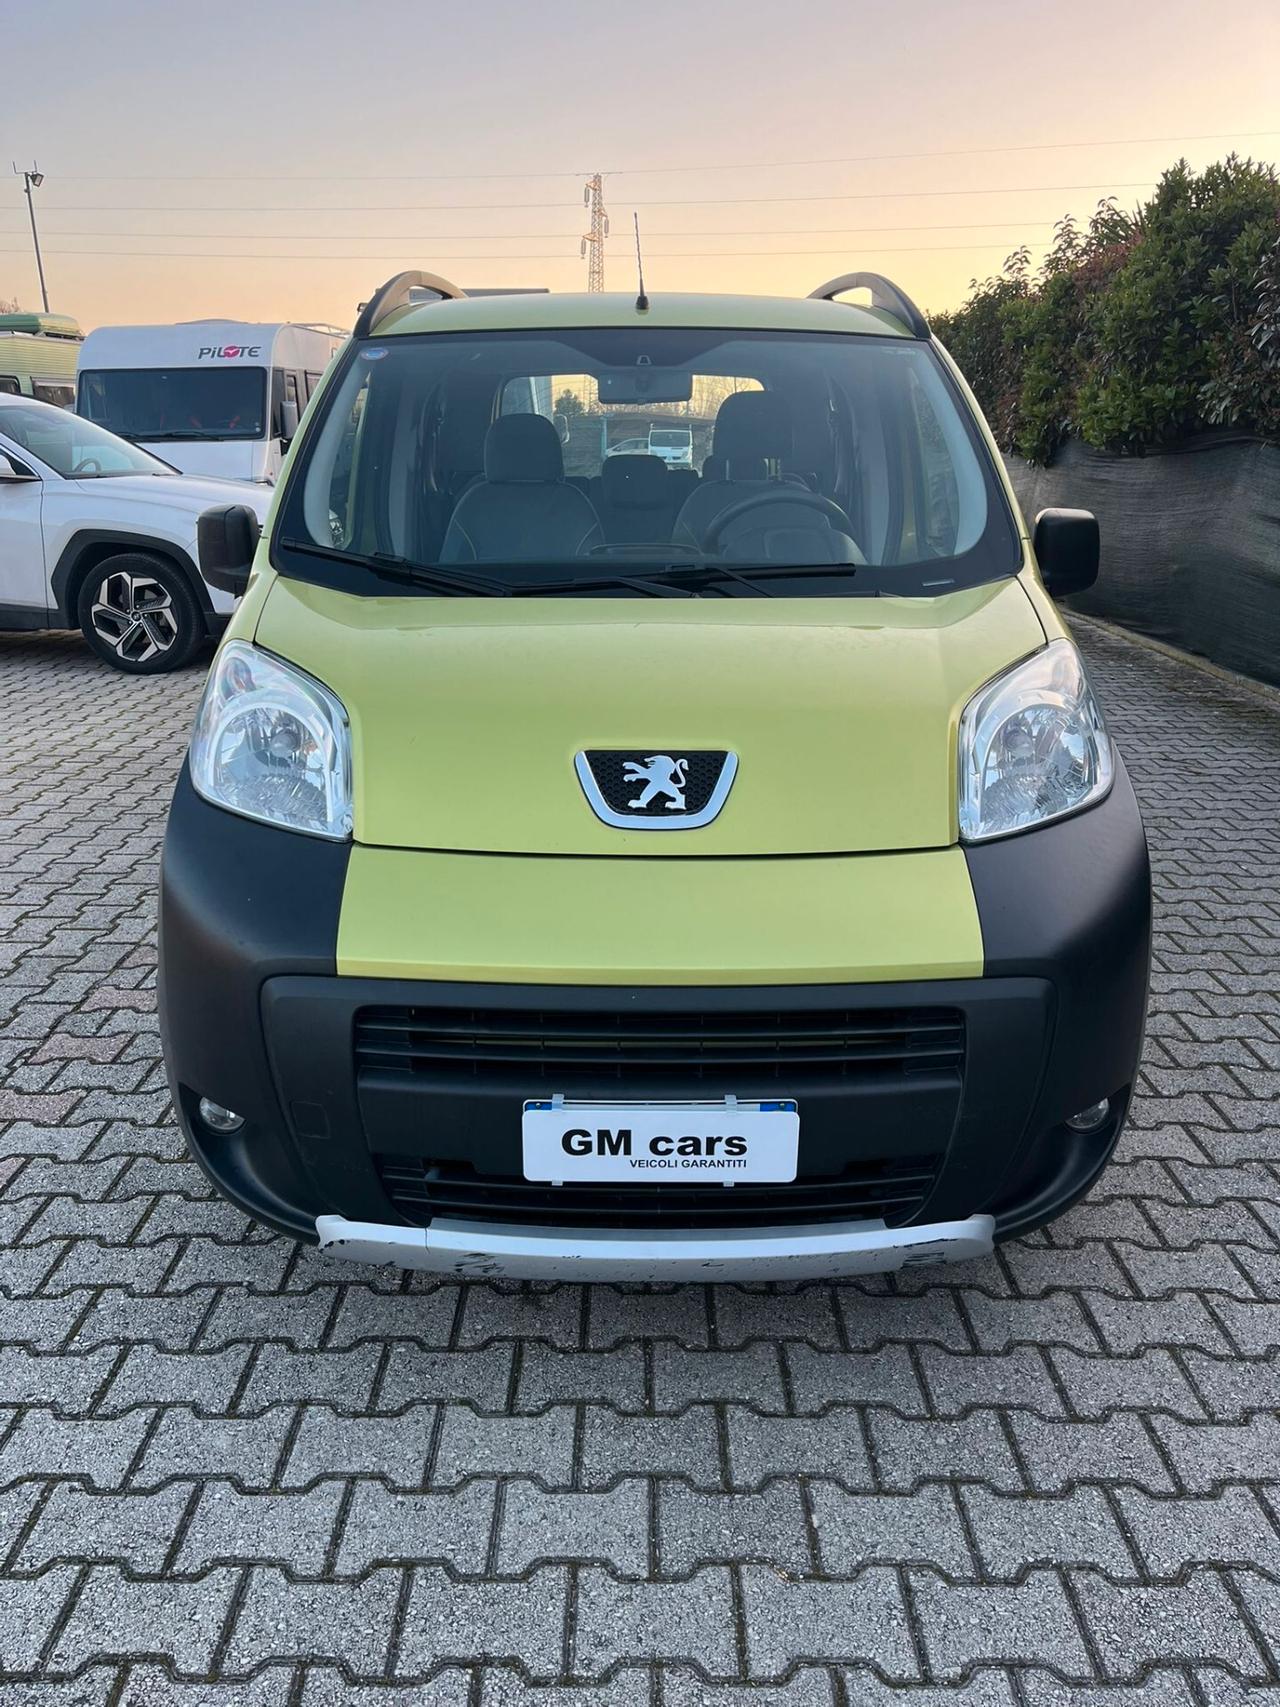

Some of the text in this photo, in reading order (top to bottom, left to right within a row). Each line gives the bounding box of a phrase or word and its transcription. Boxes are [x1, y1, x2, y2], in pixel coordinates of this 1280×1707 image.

[561, 1129, 748, 1156] GM cars
[630, 1159, 747, 1168] VEICOLI GARANTITI
